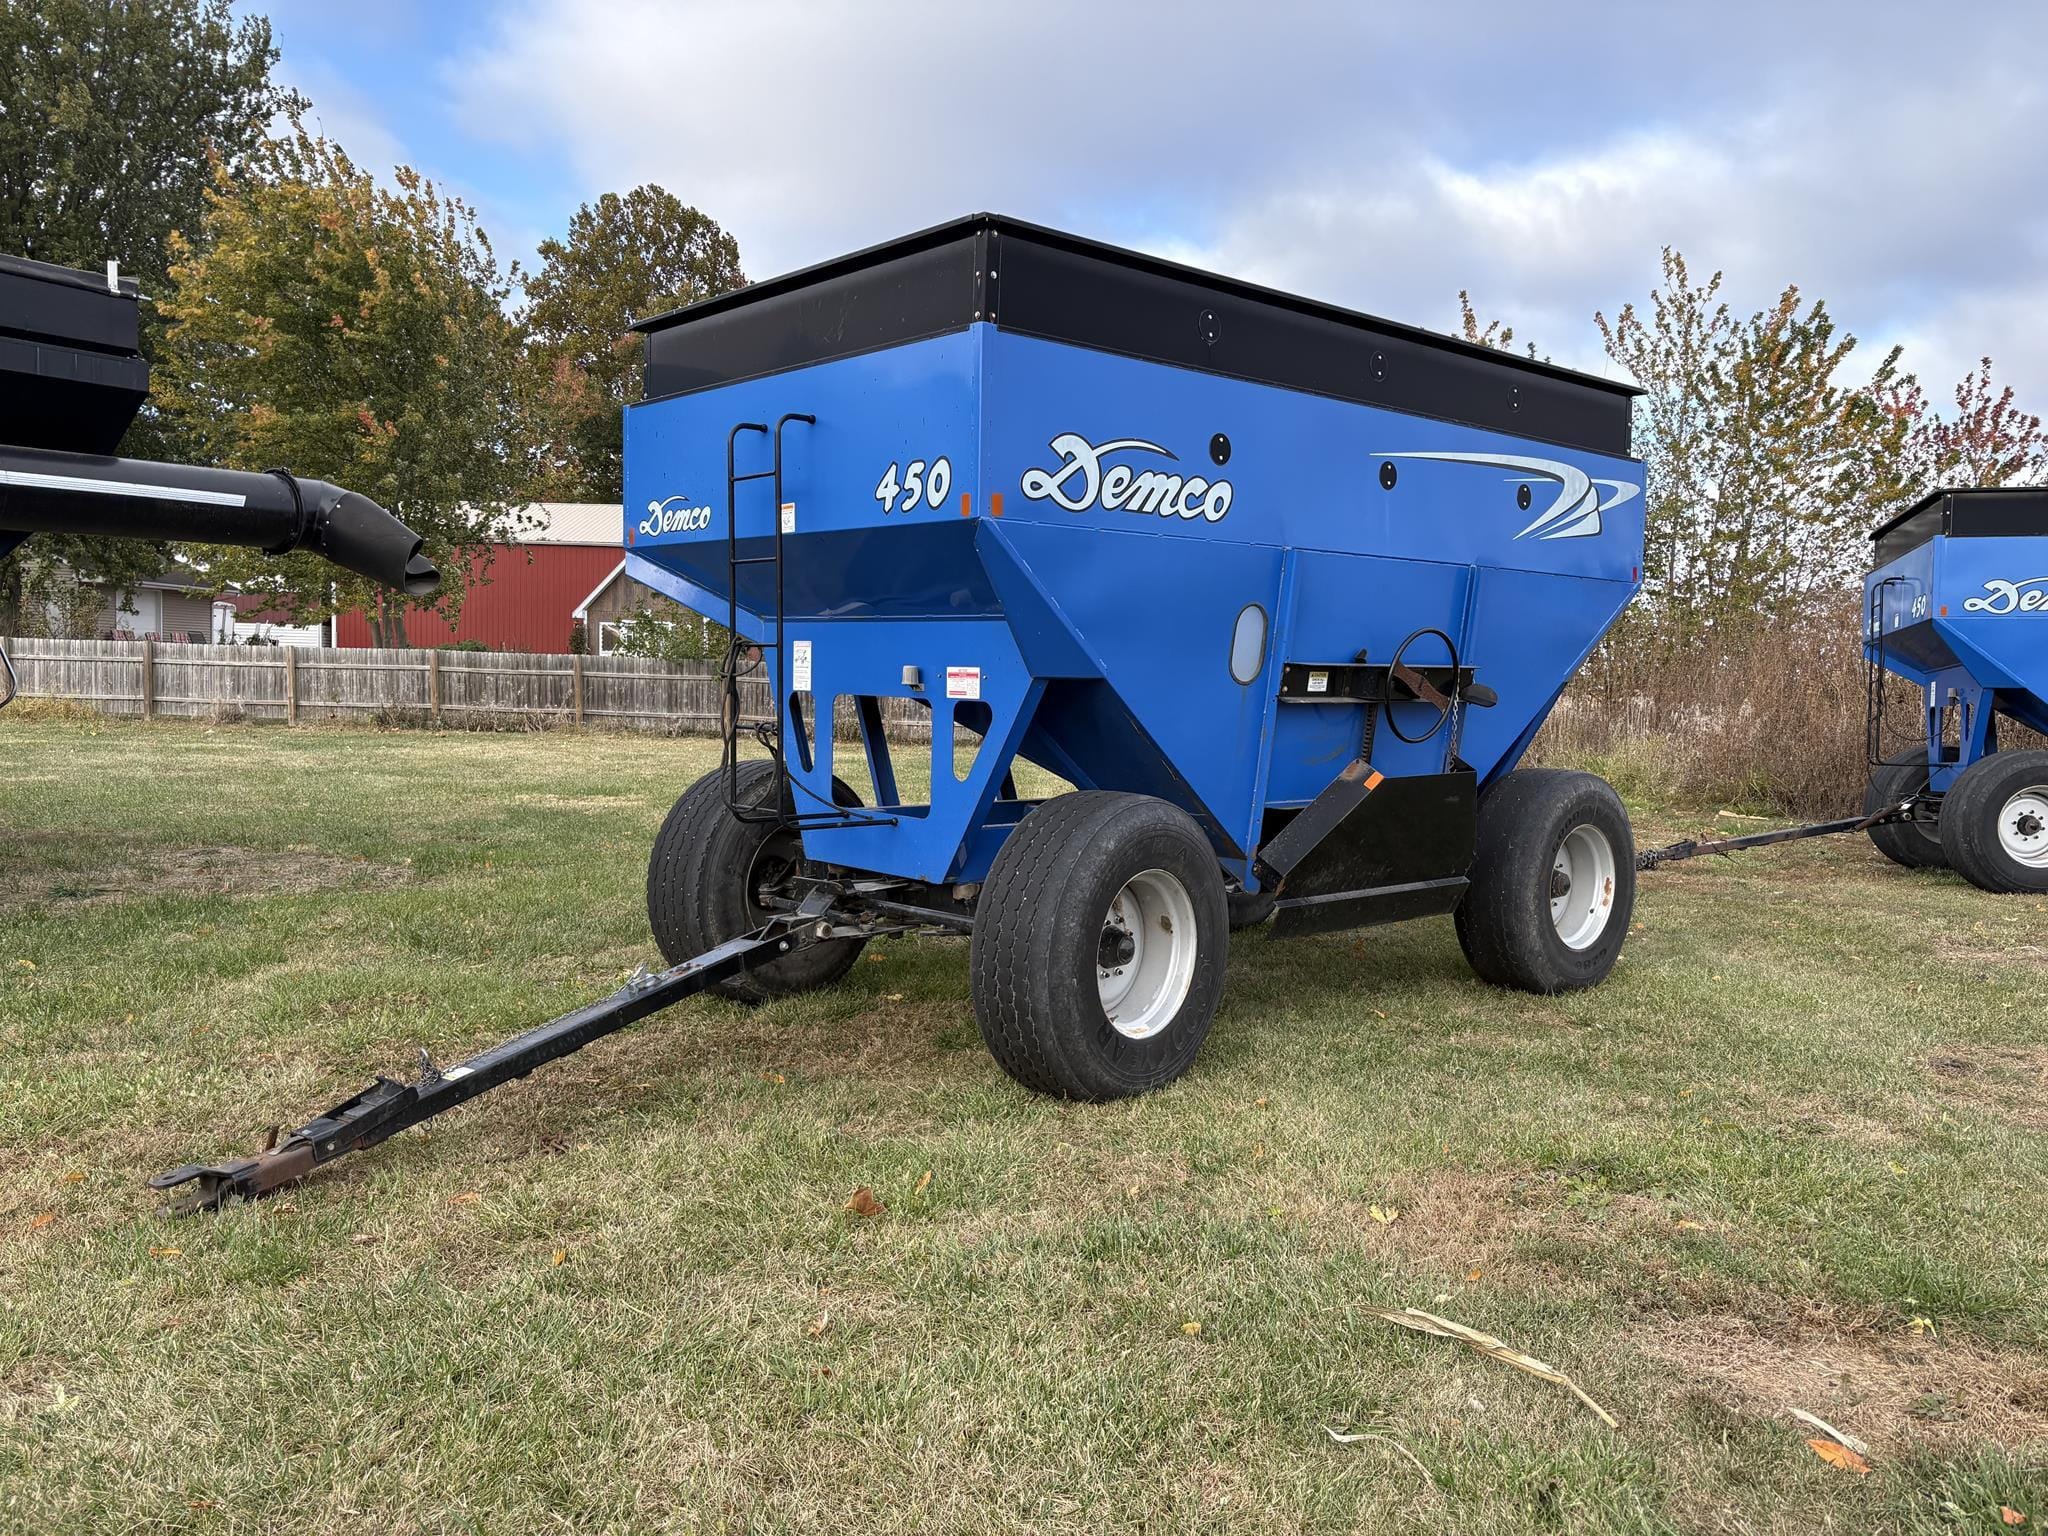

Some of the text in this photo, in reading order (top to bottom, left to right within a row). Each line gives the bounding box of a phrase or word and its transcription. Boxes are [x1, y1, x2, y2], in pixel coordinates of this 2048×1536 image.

[875, 455, 952, 516] 450
[1021, 432, 1233, 523] Demco
[639, 495, 712, 537] Demco
